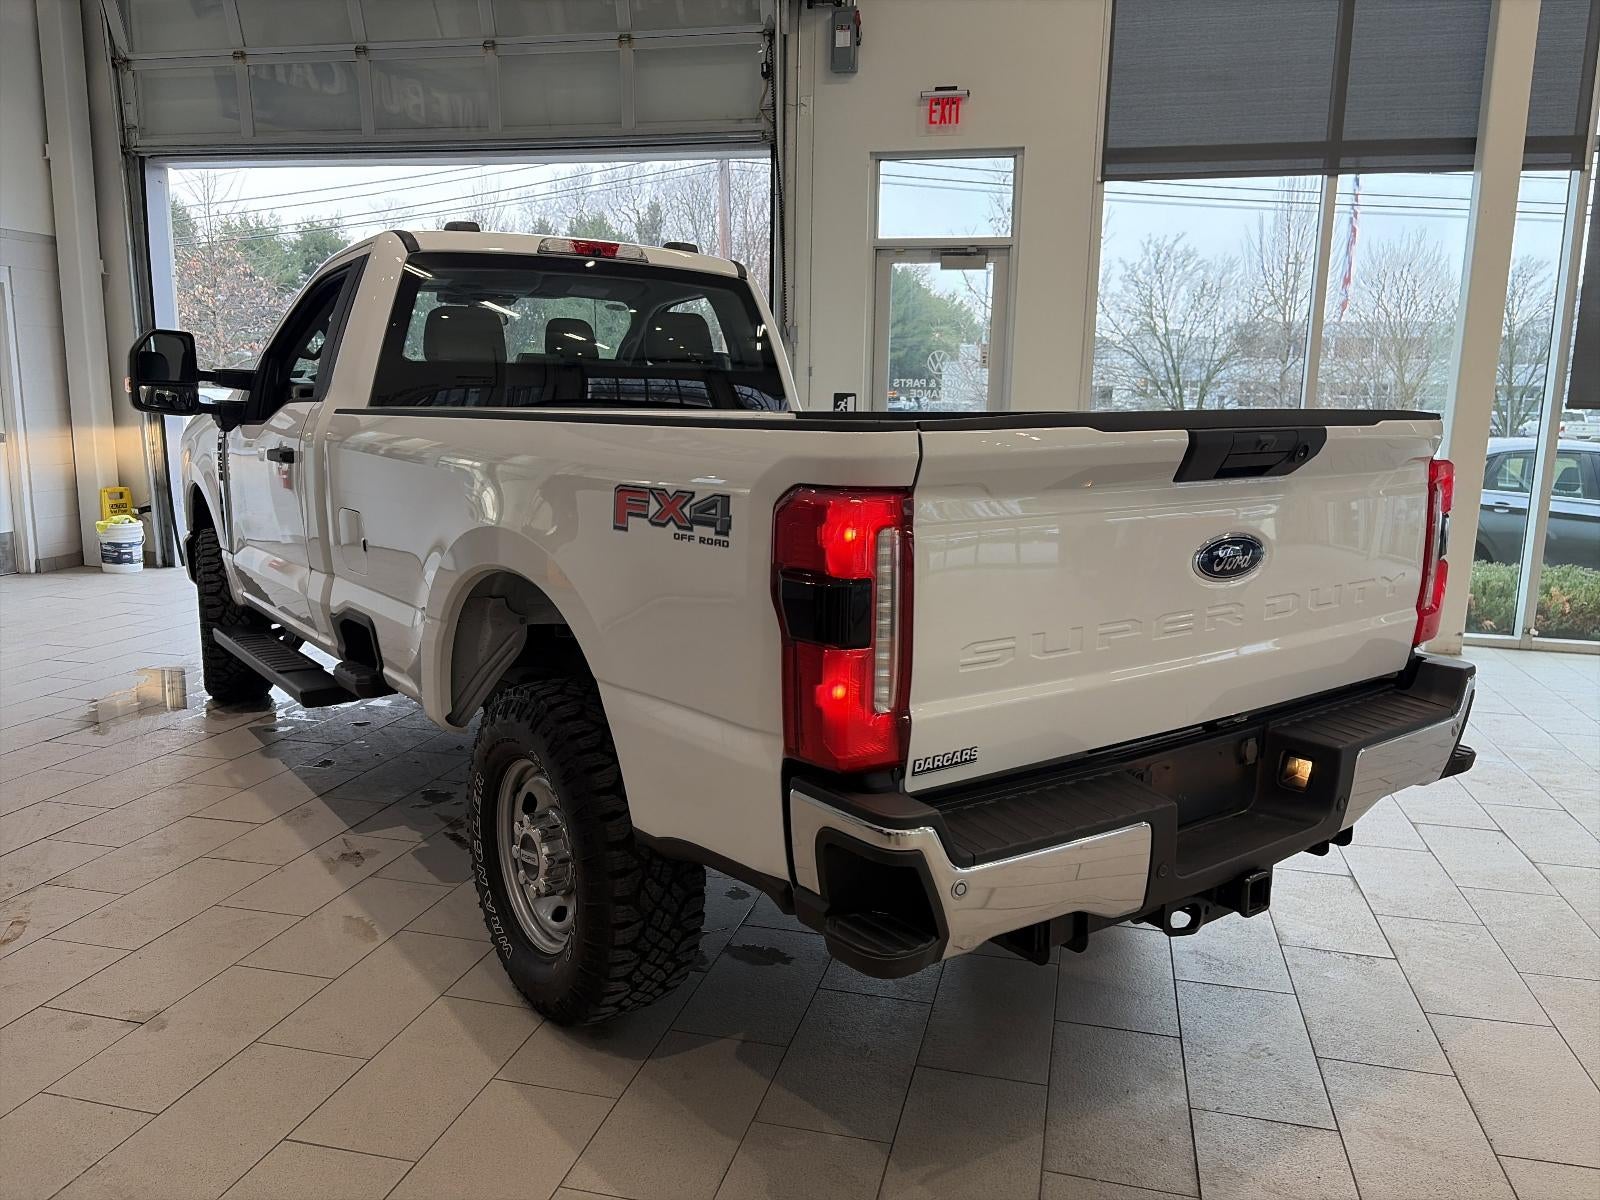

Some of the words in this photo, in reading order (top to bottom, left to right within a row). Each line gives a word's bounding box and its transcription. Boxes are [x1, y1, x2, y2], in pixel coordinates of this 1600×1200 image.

[928, 96, 963, 125] EXIT
[612, 484, 732, 538] FX4
[673, 532, 695, 543] OFF
[699, 536, 730, 548] ROAD
[1213, 544, 1253, 572] Ford
[959, 601, 1245, 673] SUPER
[1263, 572, 1406, 622] DUTY
[912, 746, 979, 775] DARCARS
[472, 772, 513, 960] WRANGLER
